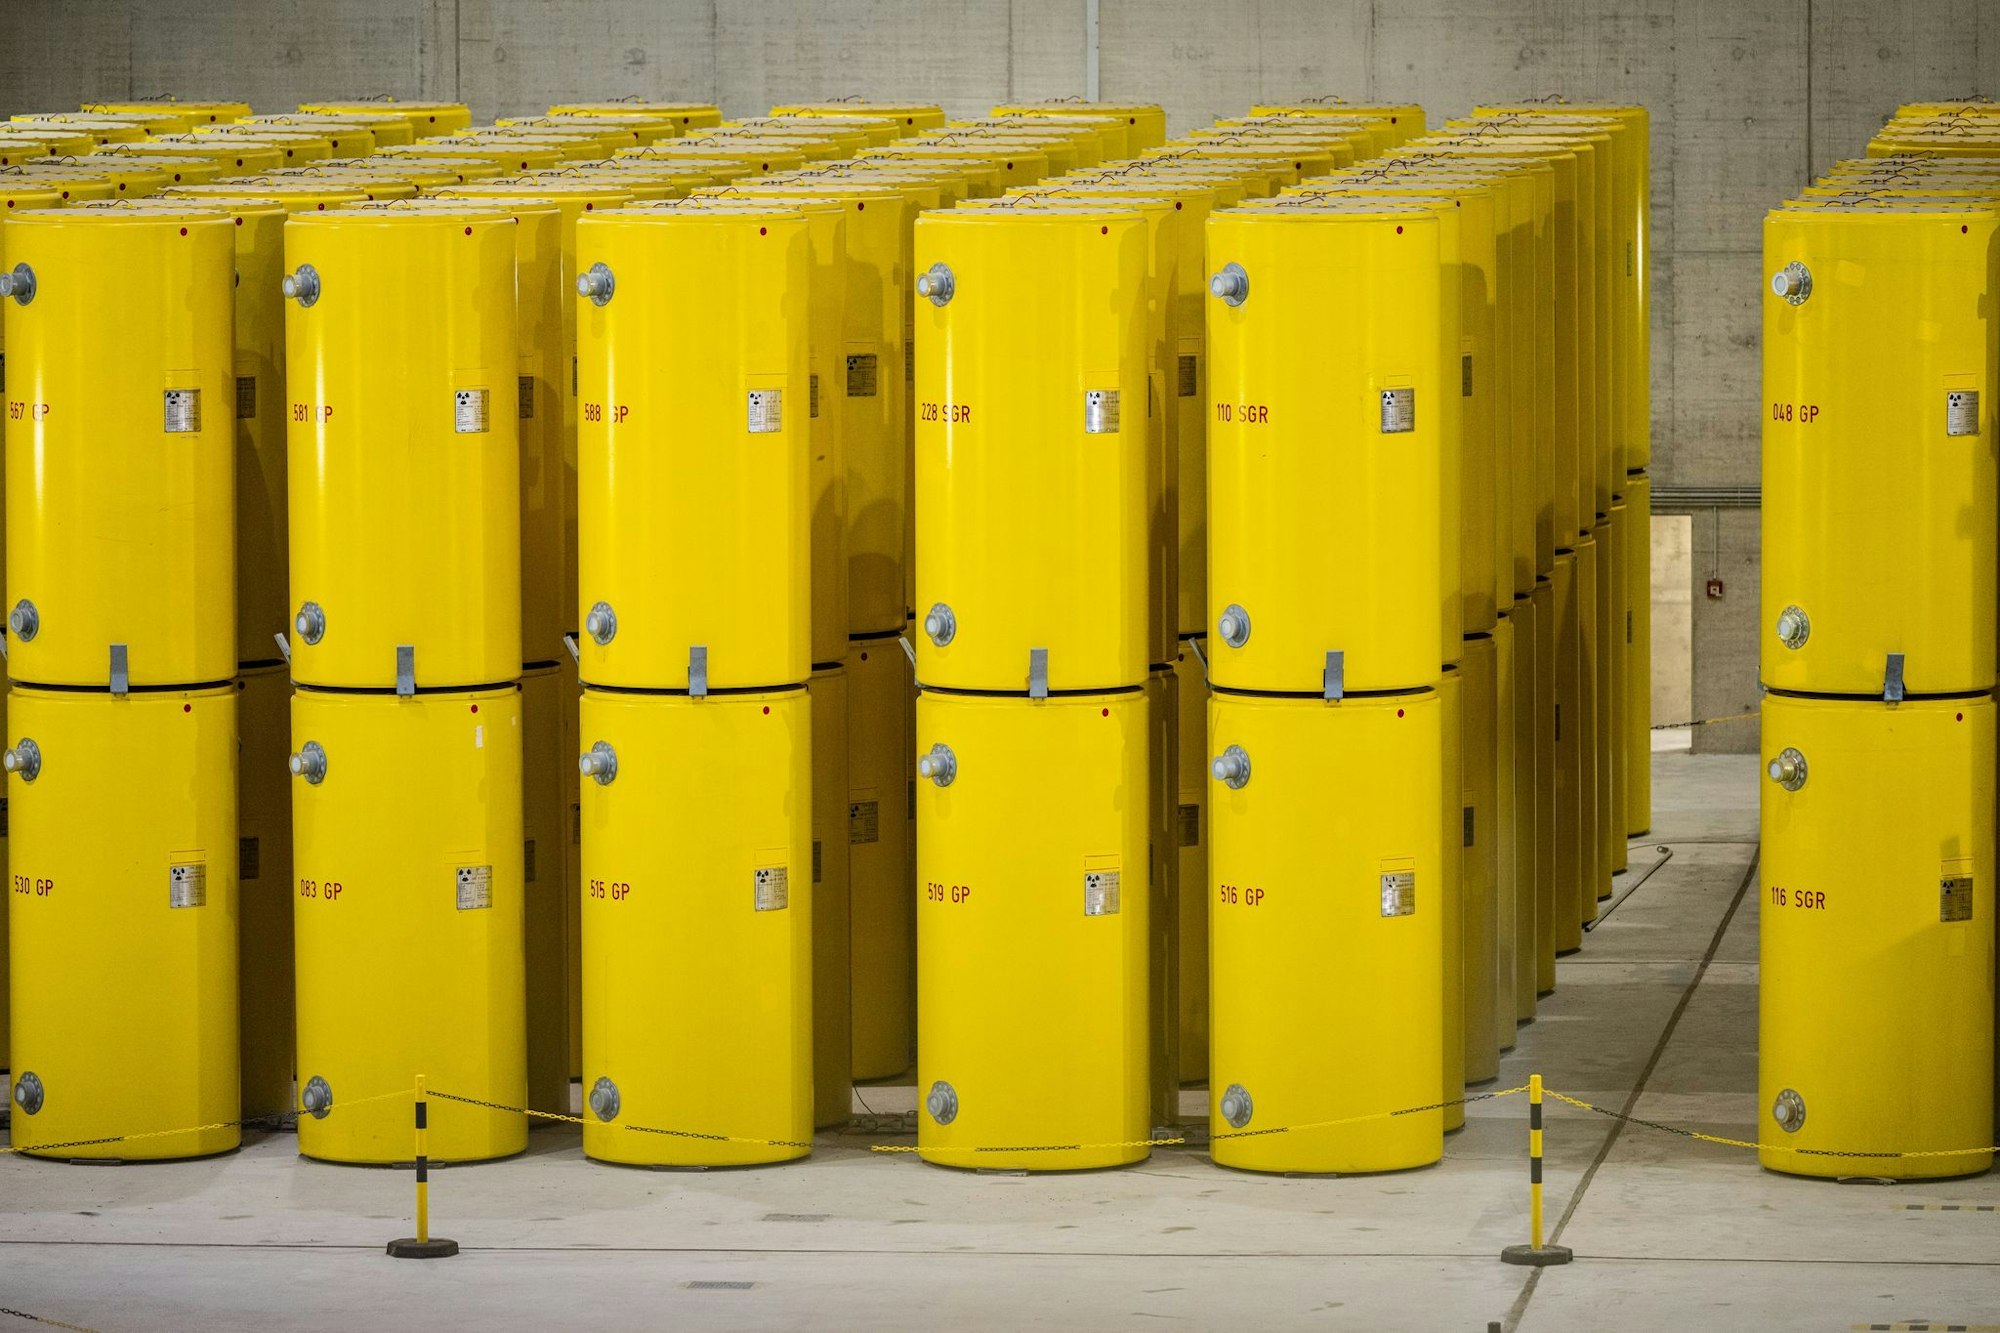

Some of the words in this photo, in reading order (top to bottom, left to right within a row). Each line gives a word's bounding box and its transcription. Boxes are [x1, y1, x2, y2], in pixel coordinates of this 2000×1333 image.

[10, 402, 25, 420] 567
[294, 404, 308, 422] 581
[584, 403, 601, 422] 588
[921, 403, 938, 421] 228
[942, 404, 971, 423] SGR
[1217, 404, 1232, 422] 110
[1239, 405, 1269, 424] SGR
[1772, 403, 1793, 422] 048
[1800, 404, 1819, 423] GP
[15, 875, 30, 894] 530
[36, 878, 54, 896] GP
[300, 879, 317, 898] 083
[324, 882, 343, 900] GP
[590, 879, 605, 899] 515
[612, 883, 630, 901] GP
[928, 882, 944, 902] 519
[951, 885, 970, 904] GP
[1220, 884, 1237, 904] 516
[1245, 888, 1265, 906] GP
[1771, 886, 1787, 906] 116
[1795, 889, 1825, 910] SGR
